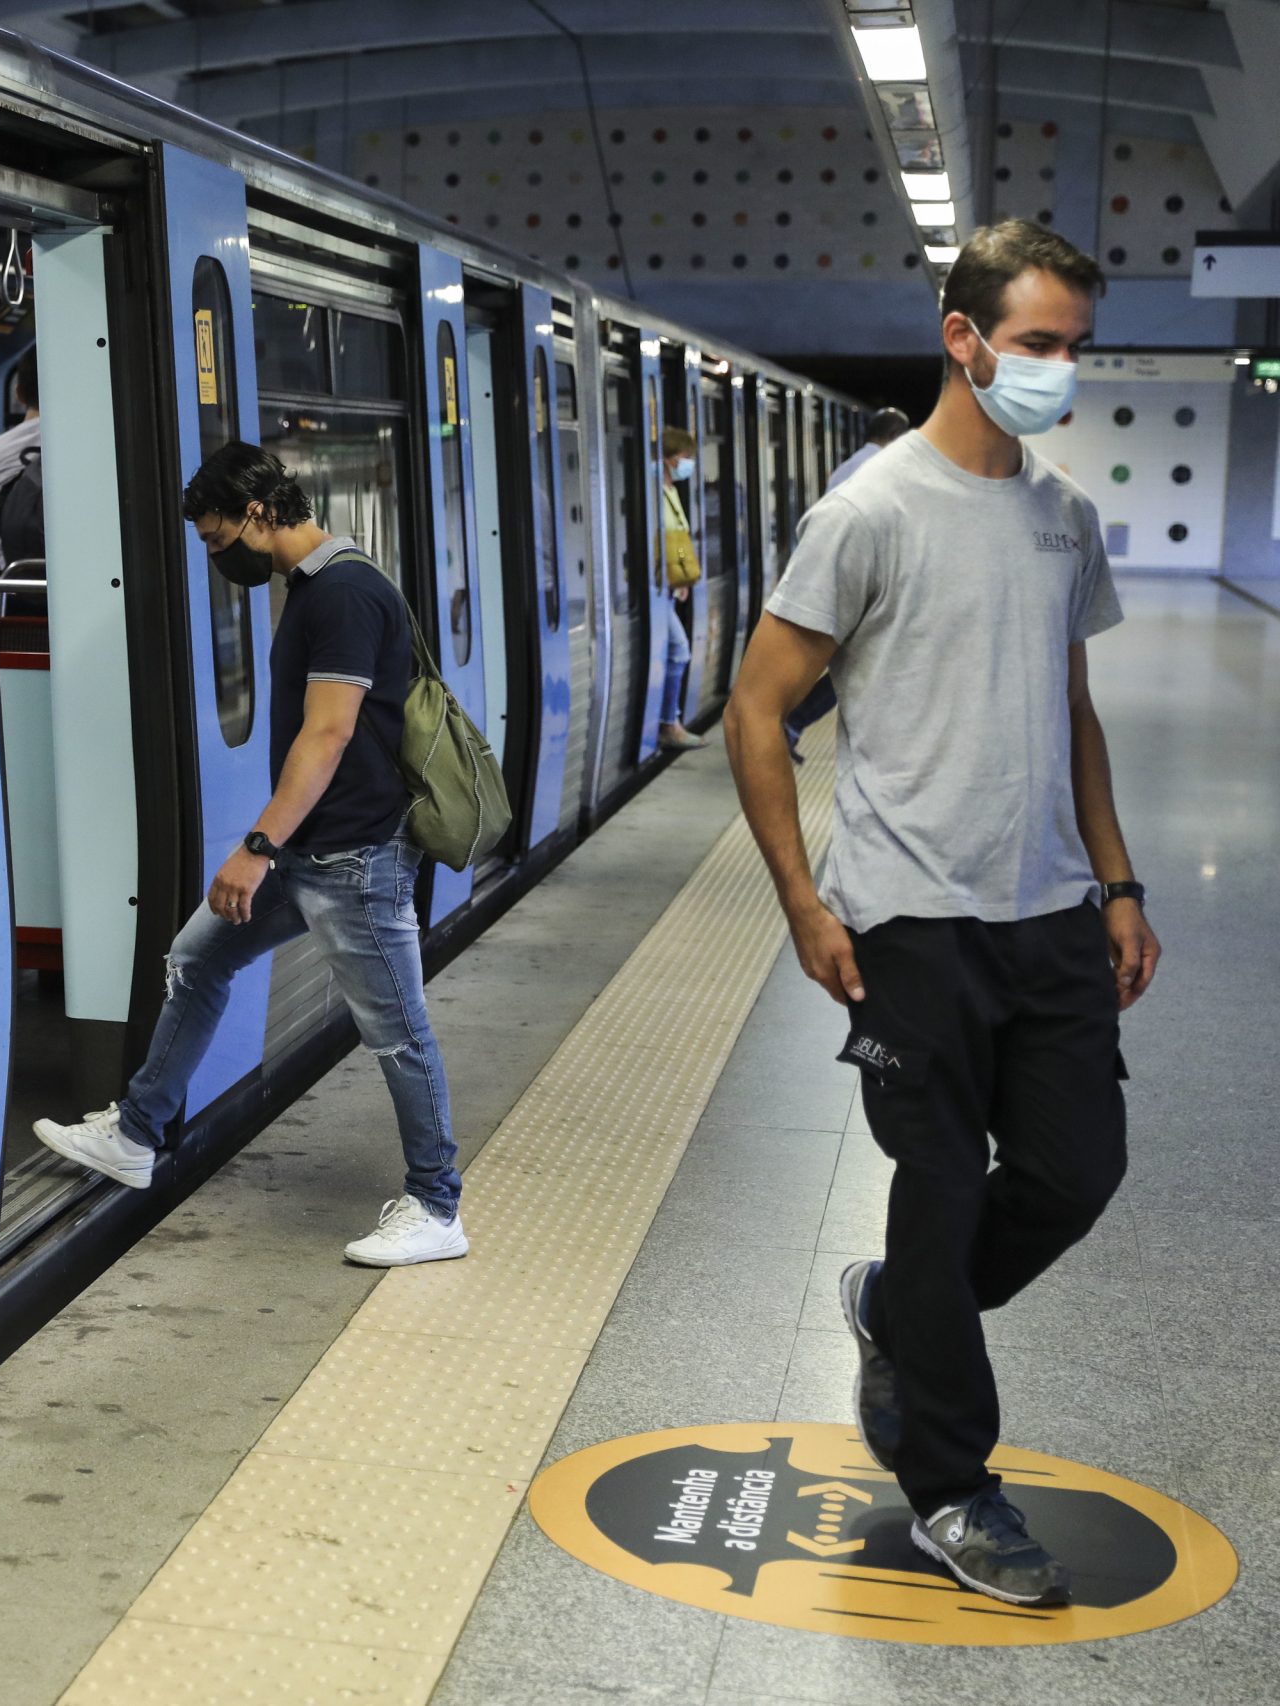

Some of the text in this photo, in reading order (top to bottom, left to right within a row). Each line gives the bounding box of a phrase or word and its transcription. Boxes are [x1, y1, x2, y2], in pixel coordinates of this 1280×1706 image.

[654, 1469, 719, 1544] Mantenha
[716, 1470, 776, 1551] a distância
